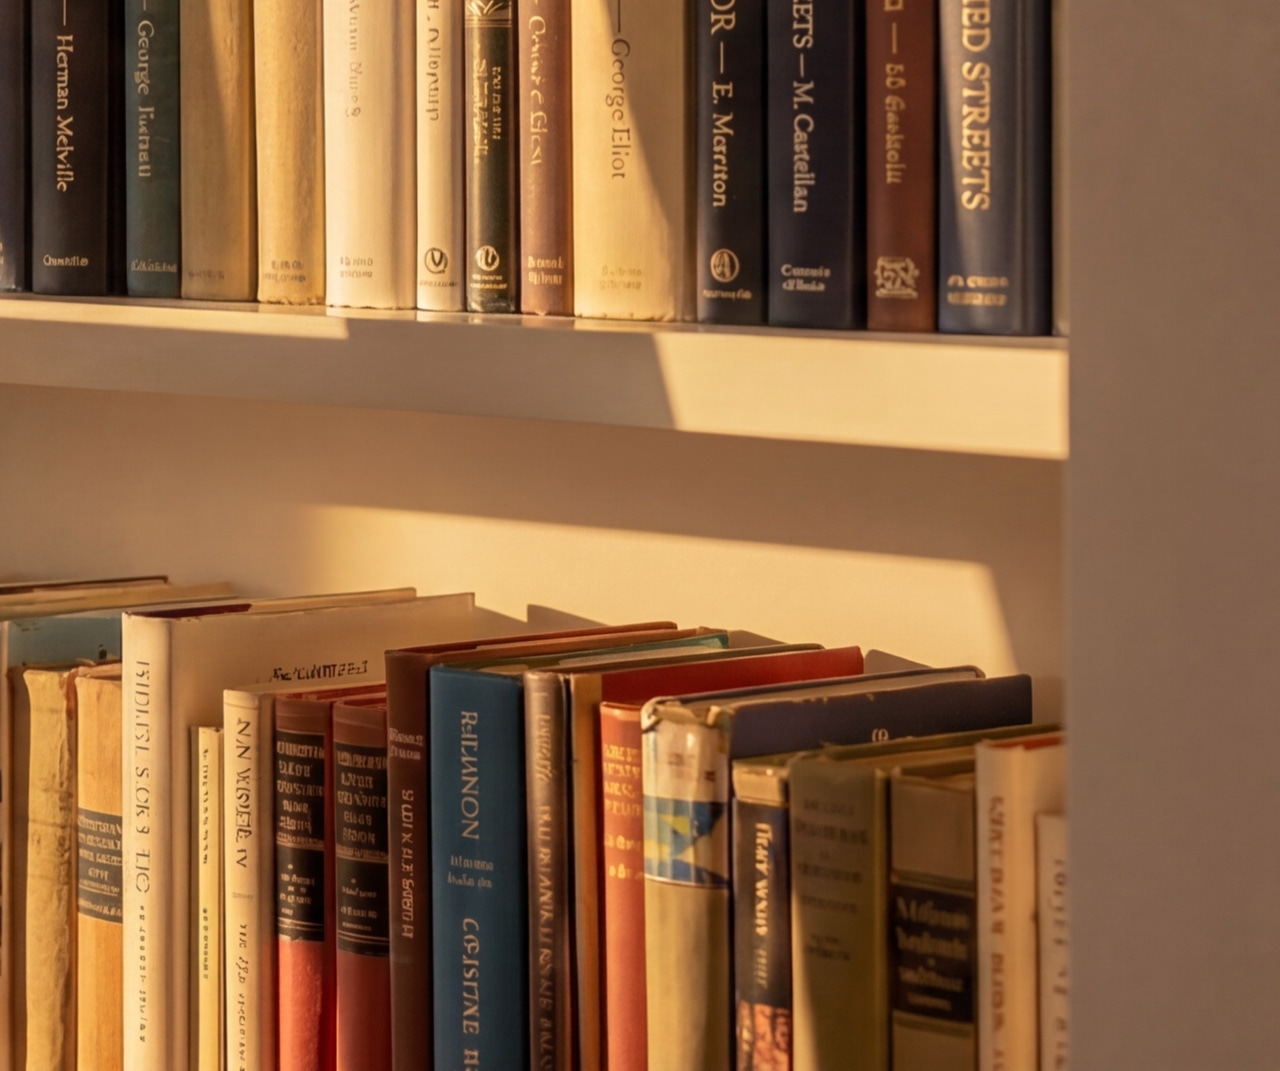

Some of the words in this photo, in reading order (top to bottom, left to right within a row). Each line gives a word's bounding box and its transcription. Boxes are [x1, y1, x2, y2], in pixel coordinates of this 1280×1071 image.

[56, 34, 74, 110] Herman
[605, 38, 631, 122] George
[712, 81, 733, 105] E.
[792, 80, 813, 110] M.
[55, 115, 75, 193] Melville
[611, 127, 632, 180] Eliot
[961, 60, 991, 211] STREETS
